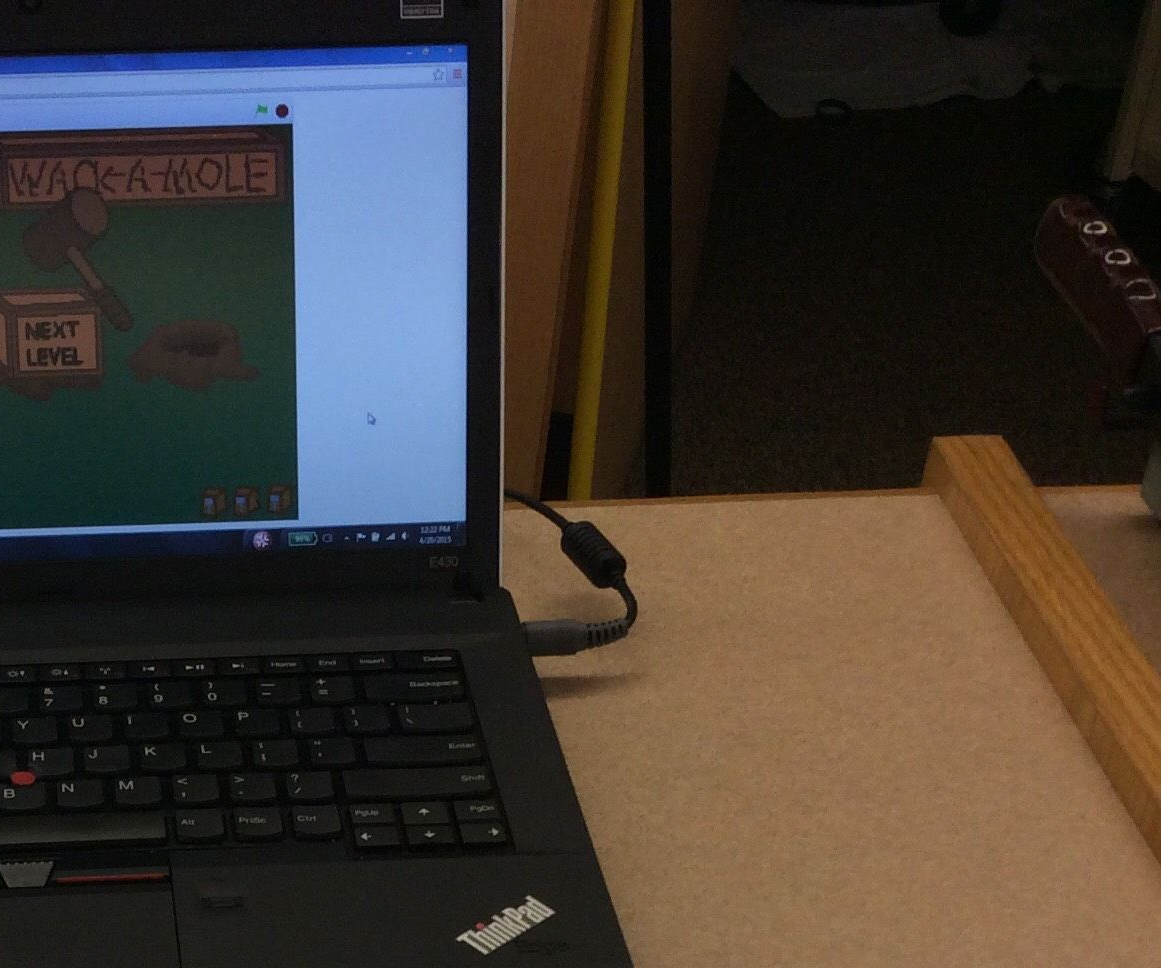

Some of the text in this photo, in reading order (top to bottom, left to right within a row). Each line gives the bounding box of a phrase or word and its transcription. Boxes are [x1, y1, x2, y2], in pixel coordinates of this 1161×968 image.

[24, 320, 80, 341] NEXT
[25, 347, 84, 368] LEVEL
[429, 555, 459, 569] E430
[318, 659, 337, 667] End
[153, 694, 164, 703] 9
[127, 715, 132, 725] I
[182, 713, 197, 724] O
[237, 711, 250, 721] P
[17, 720, 29, 730] Y
[71, 717, 85, 728] U
[144, 746, 157, 757] K
[200, 744, 212, 754] L
[31, 751, 45, 761] H
[87, 749, 98, 760] J
[61, 783, 74, 793] N
[118, 780, 135, 790] M
[3, 788, 16, 799] B
[296, 814, 317, 823] Ctrl
[455, 894, 557, 956] ThinkPad
